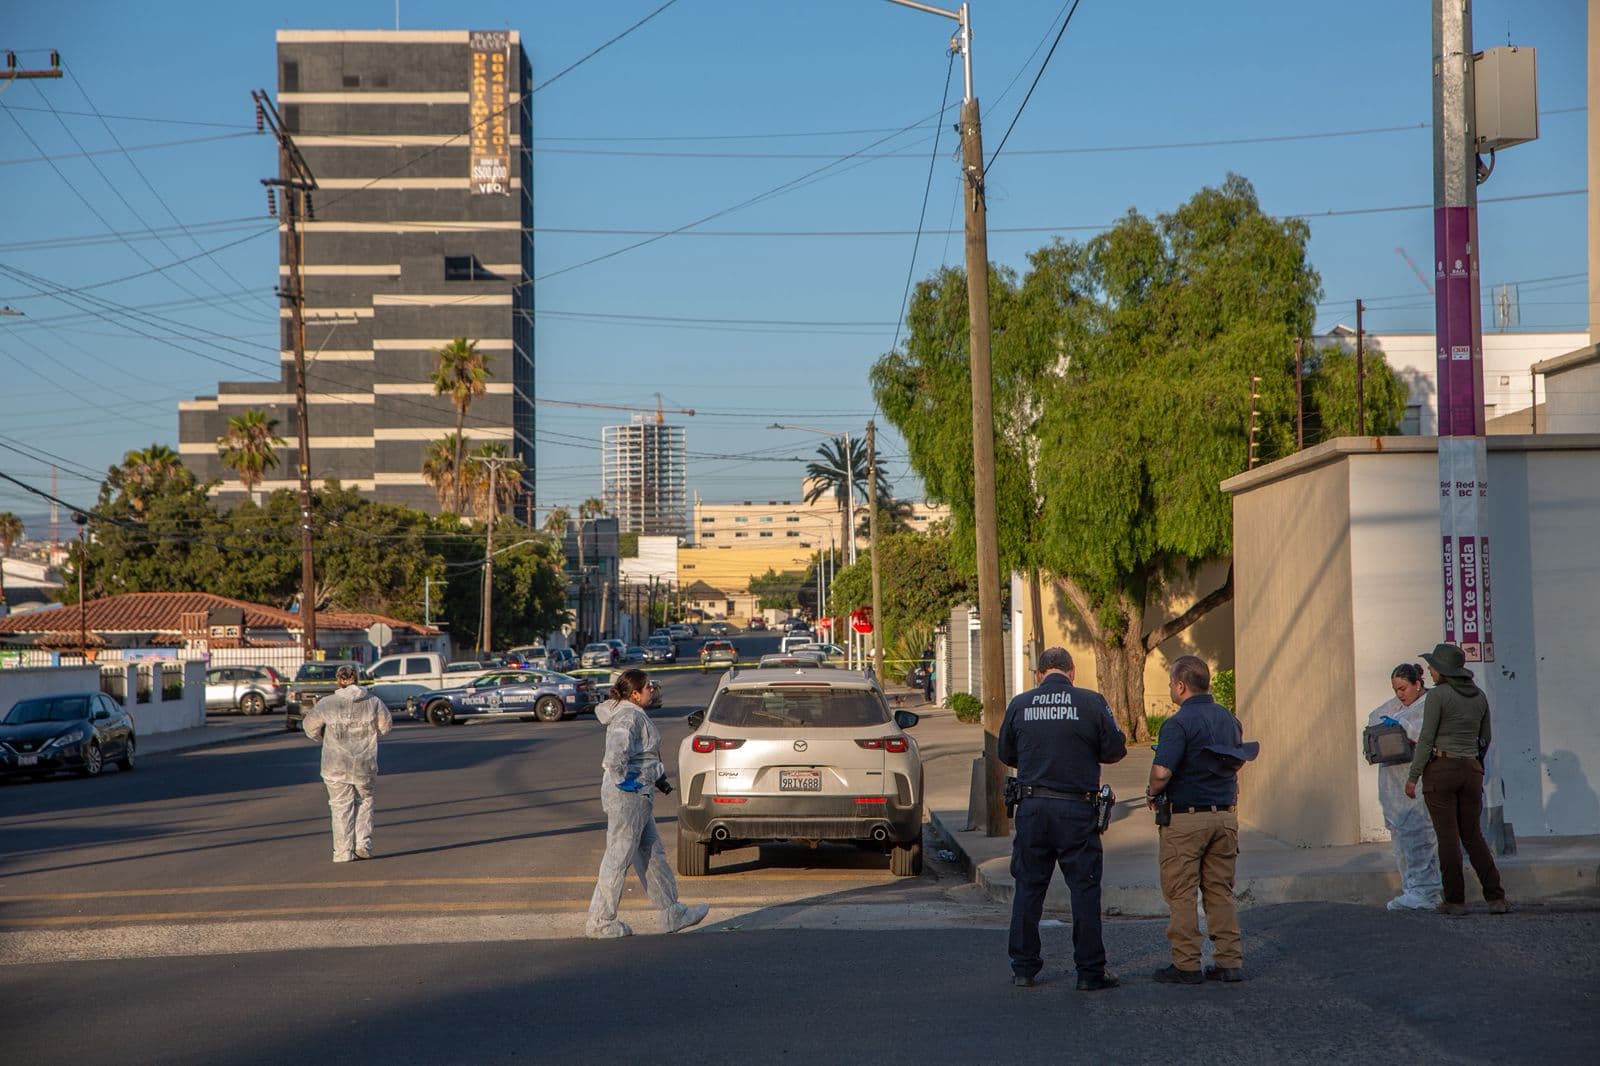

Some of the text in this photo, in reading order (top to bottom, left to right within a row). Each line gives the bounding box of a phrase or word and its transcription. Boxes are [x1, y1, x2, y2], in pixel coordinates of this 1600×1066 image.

[470, 40, 509, 48] ELEVEN
[1456, 480, 1474, 488] Red
[1459, 489, 1472, 497] BC
[1443, 543, 1454, 631] BC te cuida
[1461, 543, 1477, 633] BC te cuida
[503, 695, 536, 703] MUNICIPAL
[1032, 691, 1072, 705] POLICÍA
[1024, 706, 1079, 721] MUNICIPAL
